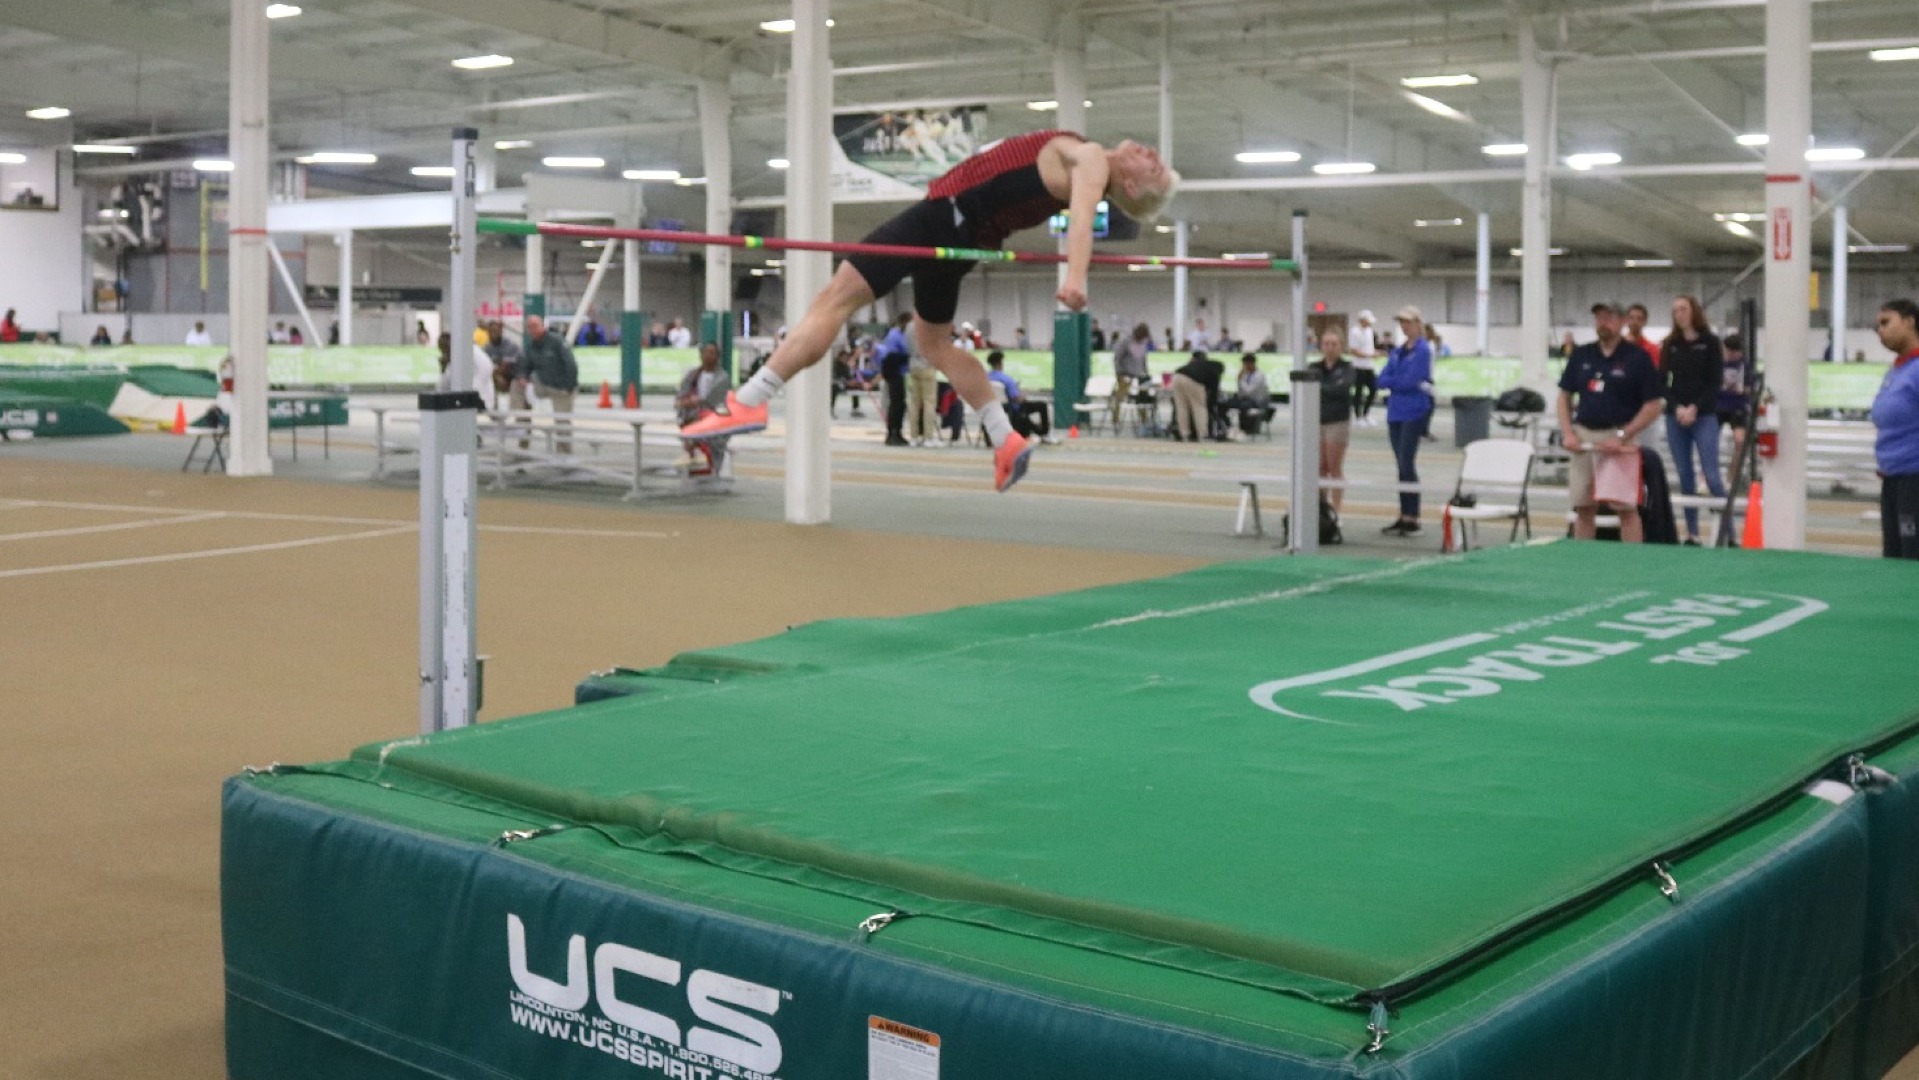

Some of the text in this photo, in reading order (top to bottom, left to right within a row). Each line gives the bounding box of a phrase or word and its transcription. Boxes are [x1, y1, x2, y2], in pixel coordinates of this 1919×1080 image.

[464, 141, 475, 197] UCS
[1597, 593, 1771, 640] FAST
[1320, 635, 1643, 711] TRACK
[1650, 641, 1752, 667] JDL
[507, 913, 782, 1075] UCS
[592, 1016, 612, 1032] NC
[617, 1024, 656, 1048] U.S.A.
[884, 1022, 930, 1043] WARNING
